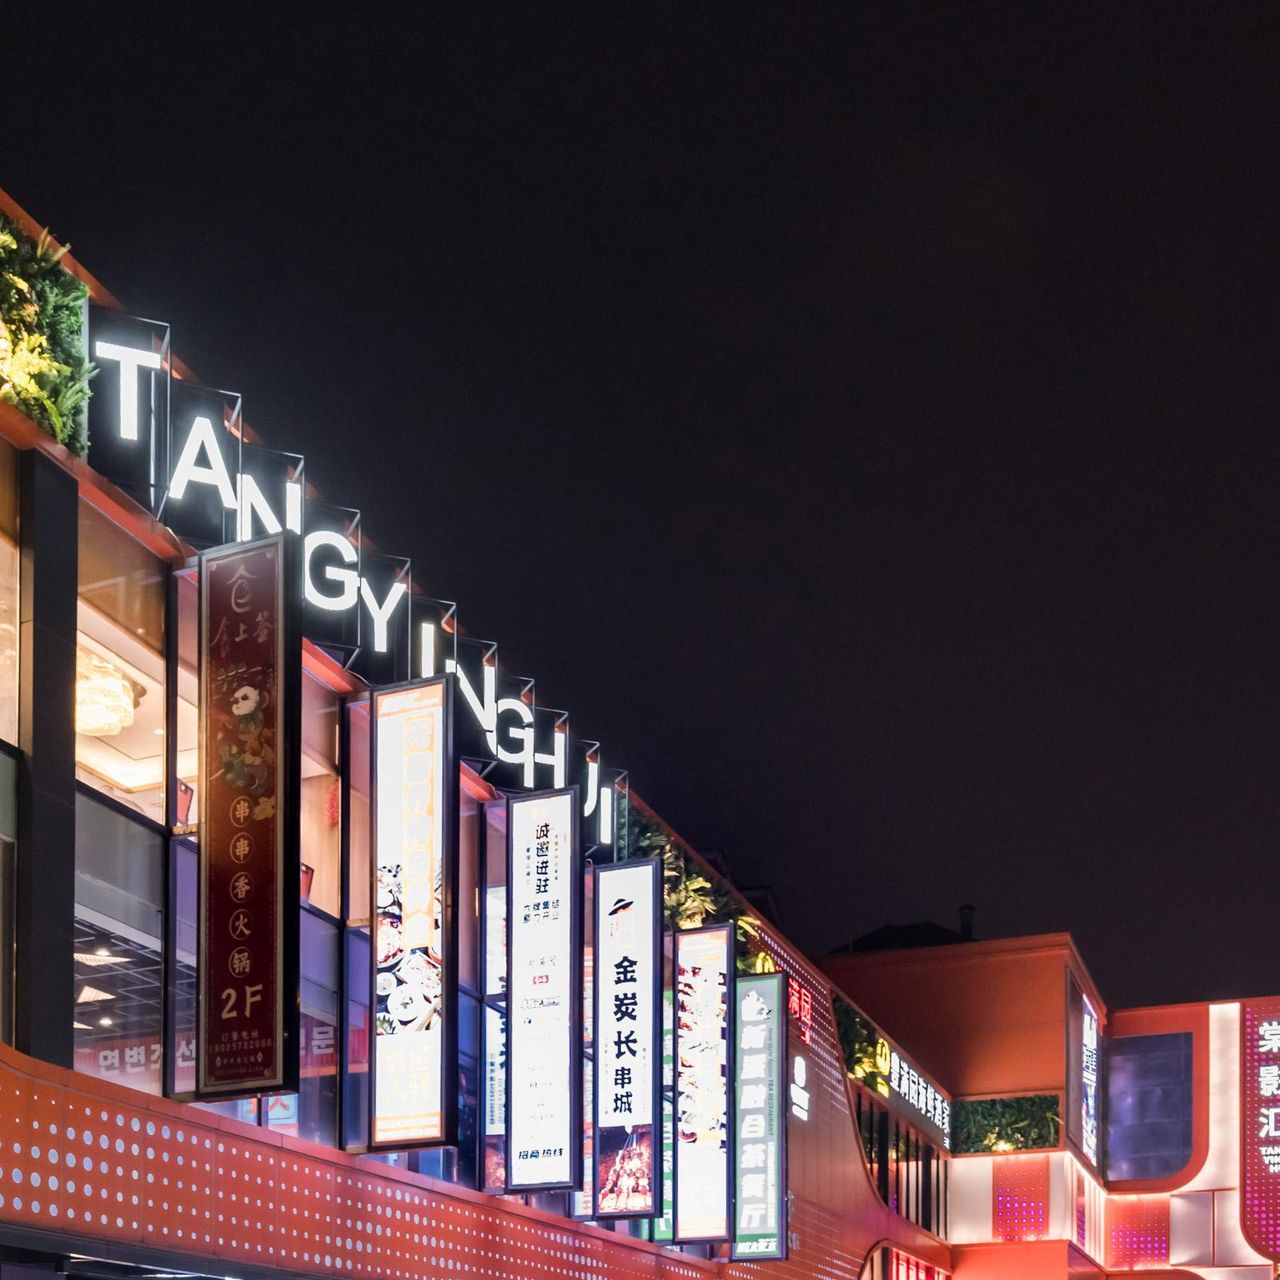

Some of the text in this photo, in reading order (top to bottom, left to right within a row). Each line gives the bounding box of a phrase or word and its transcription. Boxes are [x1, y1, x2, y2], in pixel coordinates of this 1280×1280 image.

[231, 799, 252, 976] 串串香火锅
[221, 983, 263, 1021] 2F
